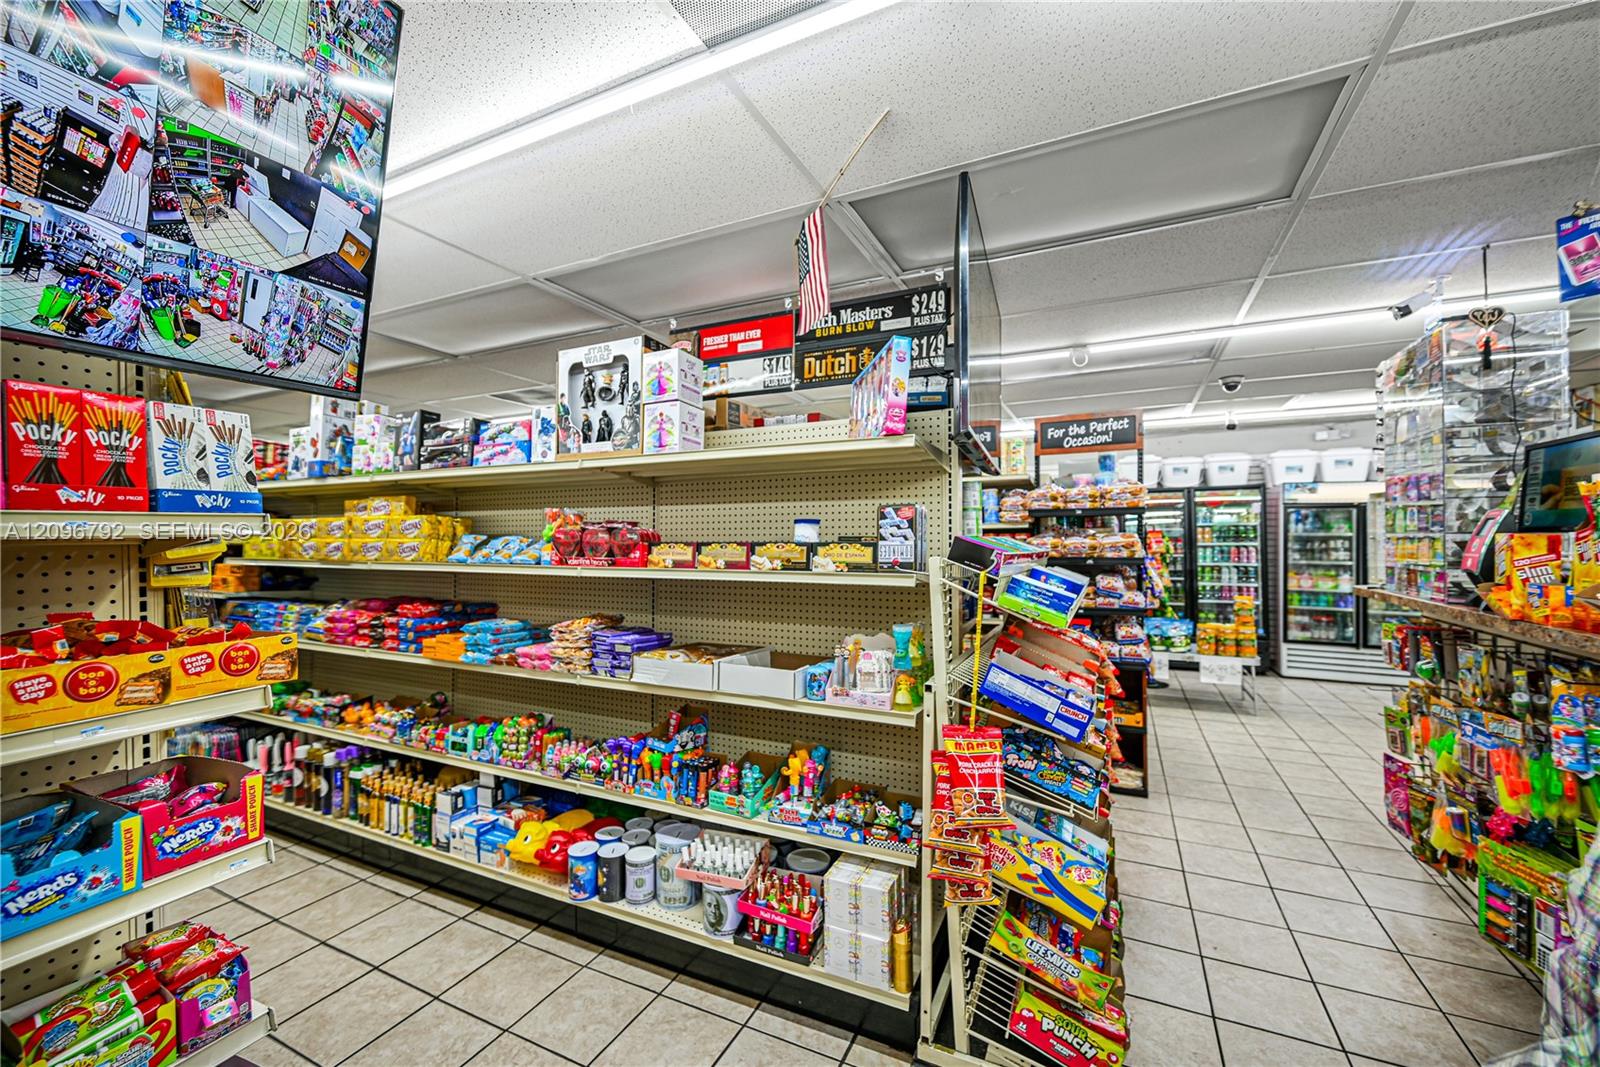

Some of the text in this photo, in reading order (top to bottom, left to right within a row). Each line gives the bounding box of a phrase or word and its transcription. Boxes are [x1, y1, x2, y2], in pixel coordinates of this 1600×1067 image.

[840, 306, 894, 325] Masters
[914, 316, 930, 326] PLUS
[931, 314, 944, 323] TAX
[815, 324, 843, 337] BURN
[846, 320, 875, 333] SLOW
[703, 334, 728, 346] FRESHER
[729, 331, 745, 342] THAN
[746, 329, 761, 340] EVER
[584, 345, 612, 356] STAR
[585, 353, 612, 365] WARS
[804, 352, 857, 379] Dutch
[913, 358, 930, 369] PLUS
[1047, 417, 1130, 440] For the Perfect
[1063, 432, 1113, 448] Occasion!
[230, 649, 250, 657] bon
[79, 670, 105, 680] bon
[188, 665, 207, 675] day
[230, 663, 250, 671] bon
[20, 690, 46, 702] day
[79, 686, 105, 696] bon
[1059, 704, 1088, 722] CRUNCH
[1005, 753, 1038, 772] Trolli
[248, 784, 258, 834] SHARE POUCH
[123, 827, 135, 884] SHARE POUCH
[1055, 1014, 1088, 1041] SOUR
[1041, 1016, 1098, 1060] PUNCH
